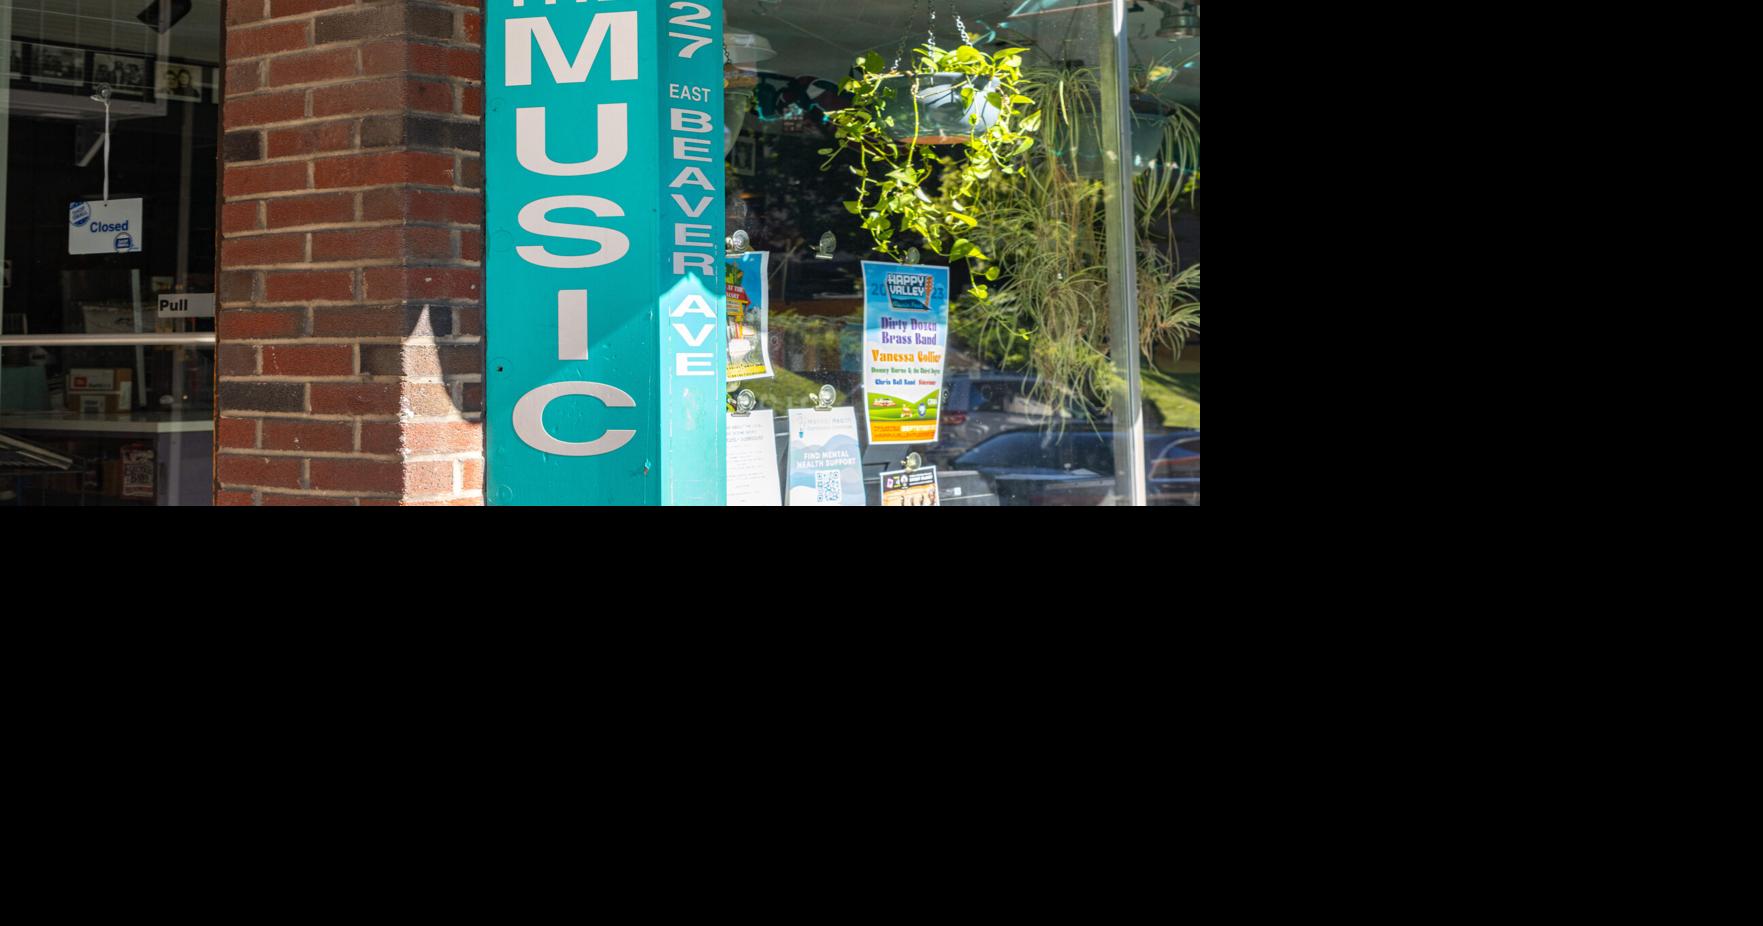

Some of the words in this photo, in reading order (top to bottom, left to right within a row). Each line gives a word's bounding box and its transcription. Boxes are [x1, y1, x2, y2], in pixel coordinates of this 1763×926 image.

[669, 83, 711, 102] EAST
[668, 107, 716, 276] BEAVER
[90, 220, 129, 233] Closed
[504, 10, 639, 457] MUSIC
[887, 273, 924, 286] HAPPY
[889, 285, 925, 296] VALLEY
[159, 299, 188, 311] Pull
[881, 317, 908, 332] Dirty
[911, 318, 937, 331] Dozen
[670, 294, 717, 376] AVE
[881, 331, 912, 345] Brass
[915, 333, 937, 345] Band
[871, 349, 914, 363] Vanessa
[804, 452, 821, 461] FIND
[822, 450, 849, 459] MENTAL
[797, 460, 825, 469] HEALTH
[825, 457, 857, 467] SUPPORT
